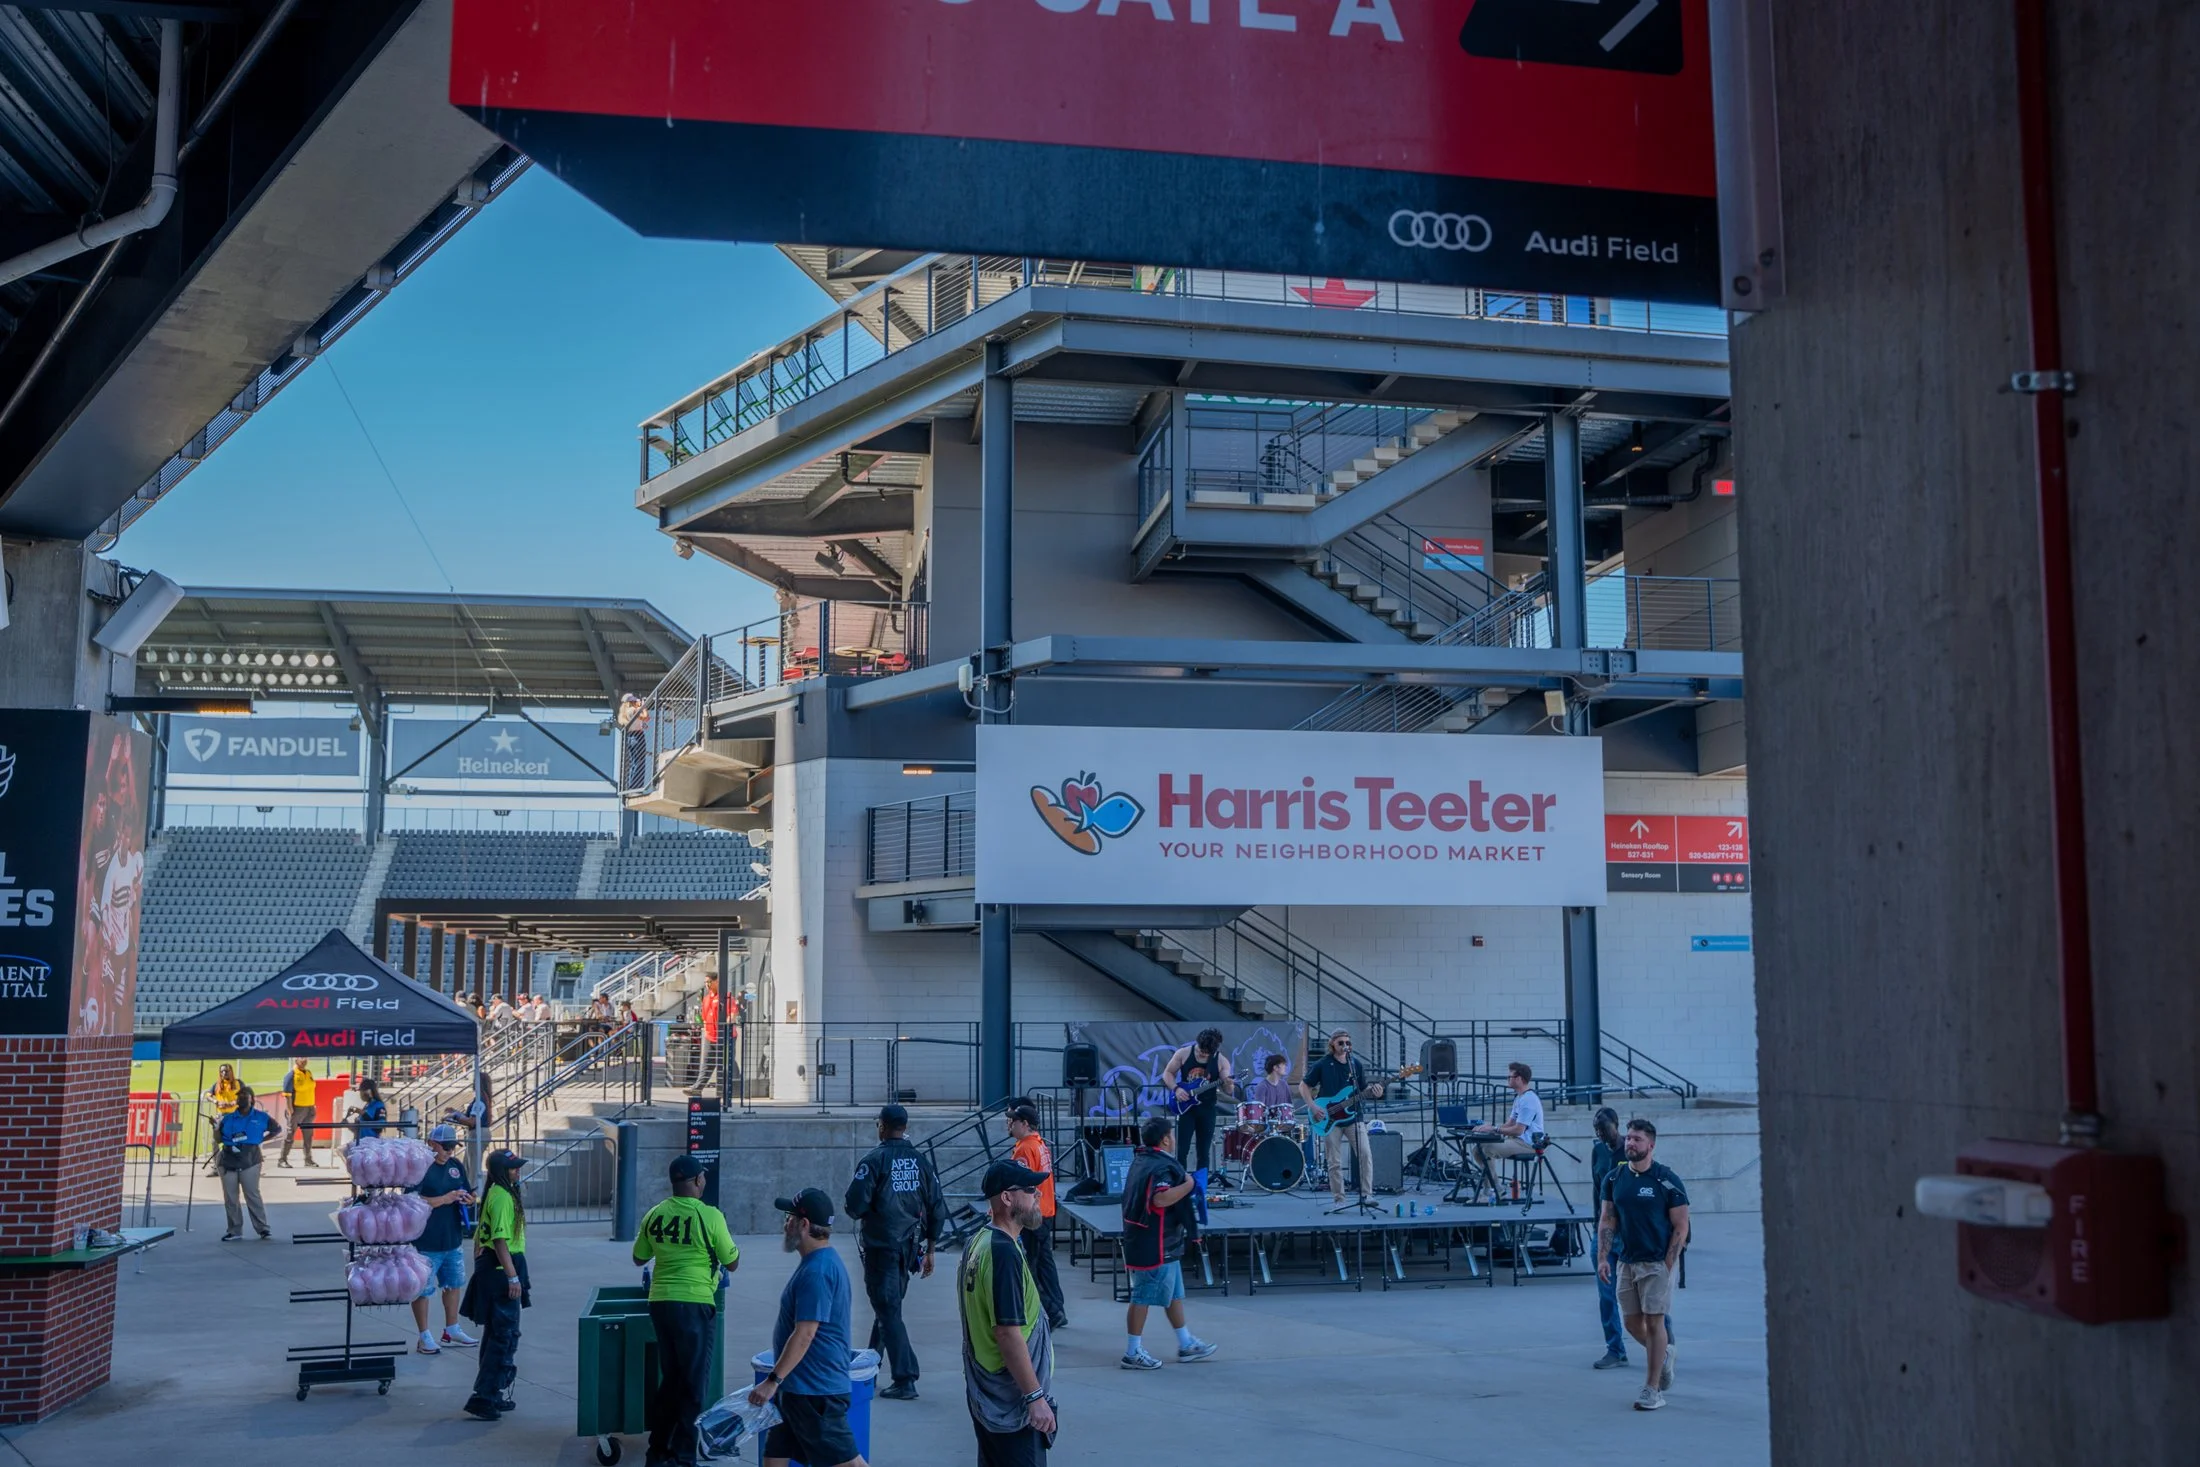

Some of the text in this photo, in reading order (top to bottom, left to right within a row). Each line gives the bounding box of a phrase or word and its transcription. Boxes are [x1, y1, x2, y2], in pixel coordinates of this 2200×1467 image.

[1525, 230, 1679, 263] Audi Field
[228, 737, 347, 757] FANDUEL
[457, 756, 550, 776] Heineken
[1159, 842, 1546, 861] YOUR NEIGHBORHOOD MARKET
[256, 997, 399, 1010] Audi Field
[292, 1028, 415, 1048] Audi Field
[891, 1158, 919, 1170] APEX
[891, 1169, 920, 1181] SECURITY
[892, 1180, 920, 1192] GROUP
[649, 1214, 692, 1245] 441
[2069, 1194, 2088, 1282] FIRE
